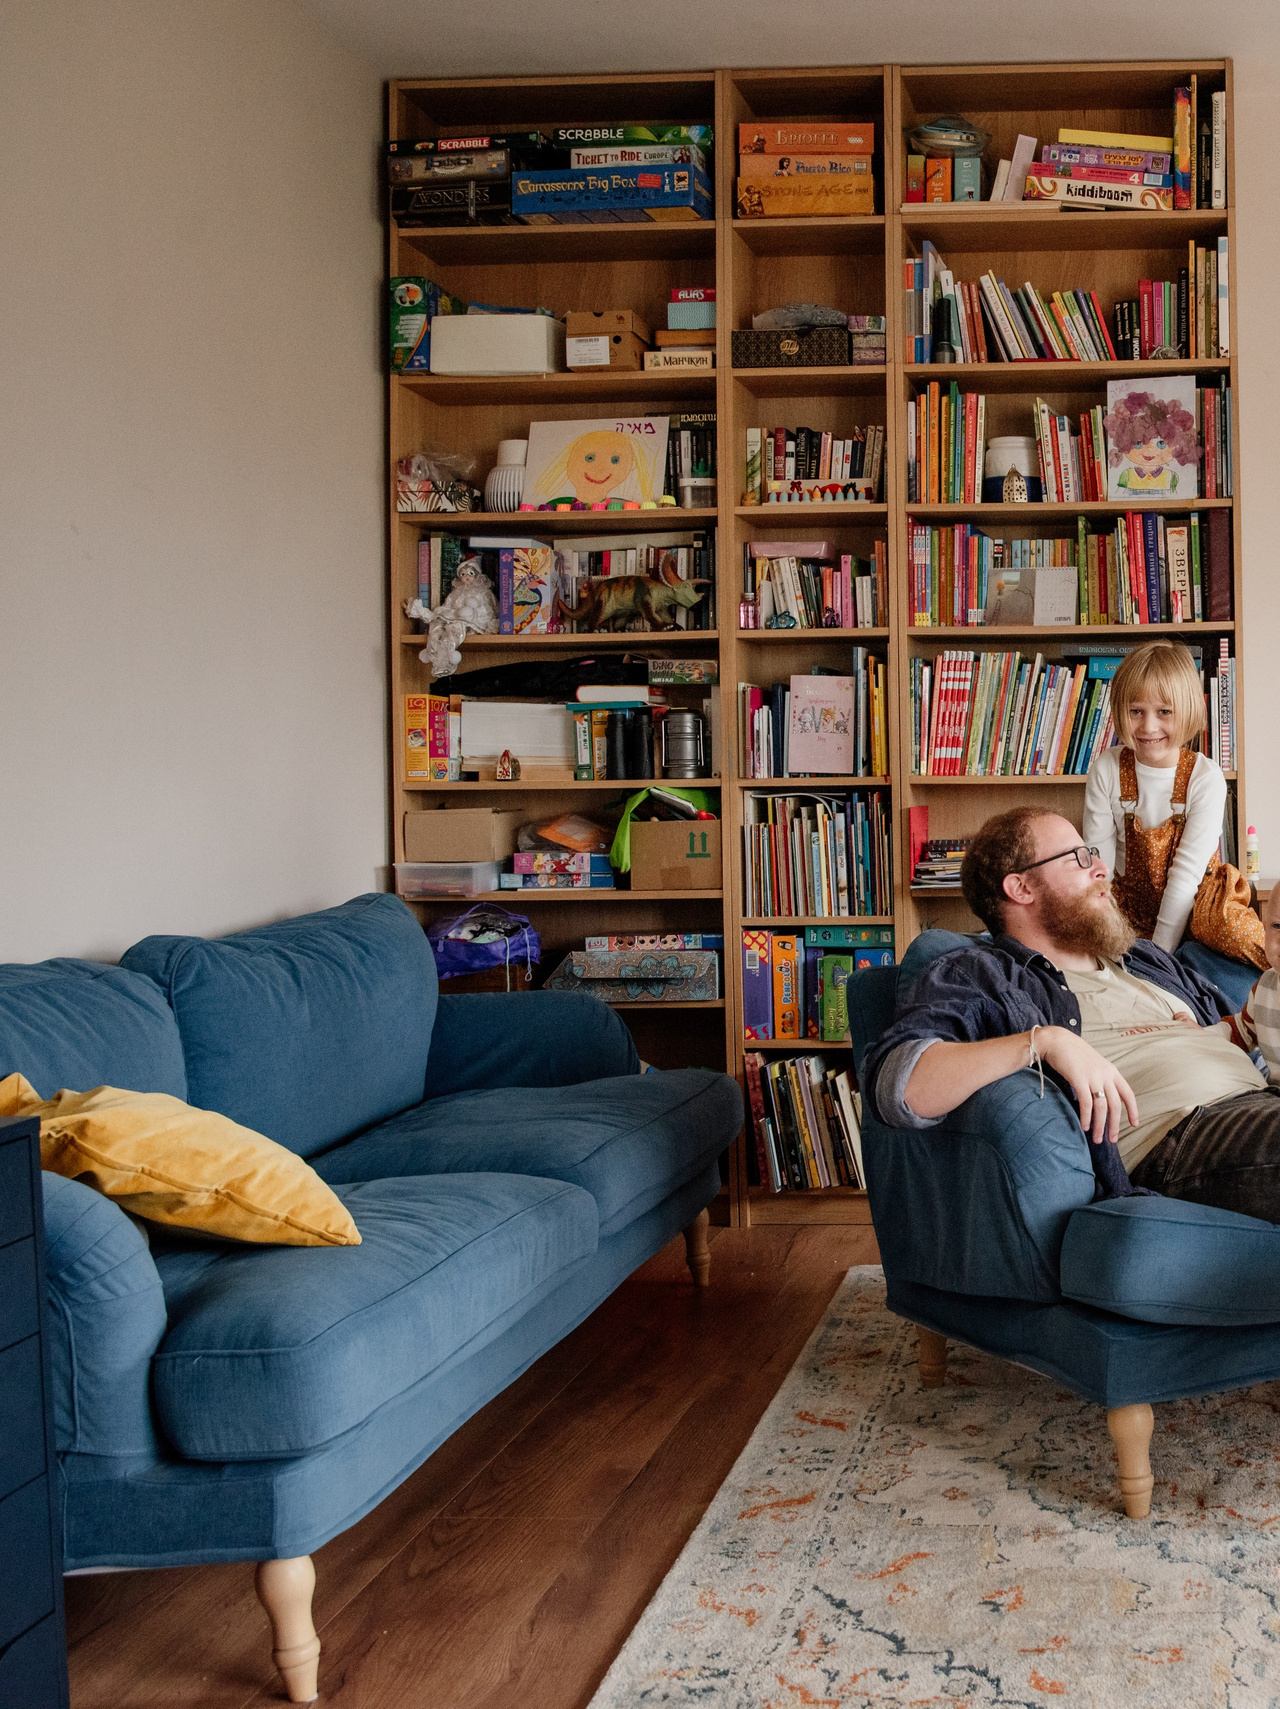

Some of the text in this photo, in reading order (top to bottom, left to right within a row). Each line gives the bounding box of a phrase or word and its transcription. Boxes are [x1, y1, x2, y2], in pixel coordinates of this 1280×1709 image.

[558, 128, 624, 141] SCRABBLE
[440, 138, 489, 150] SCRABBLE
[575, 152, 609, 165] TICKET
[620, 150, 642, 162] RIDE
[644, 151, 669, 160] EUROPE
[795, 161, 852, 174] Puerto Rico
[517, 179, 585, 195] Carcassonne
[586, 176, 609, 193] Big
[610, 174, 637, 188] Box
[1128, 172, 1140, 184] 4
[761, 185, 813, 198] STONE
[816, 183, 854, 197] AGE
[1066, 184, 1133, 202] kiddiboom
[616, 422, 656, 434] מאיה
[408, 698, 426, 709] IQ
[430, 700, 440, 711] IQ
